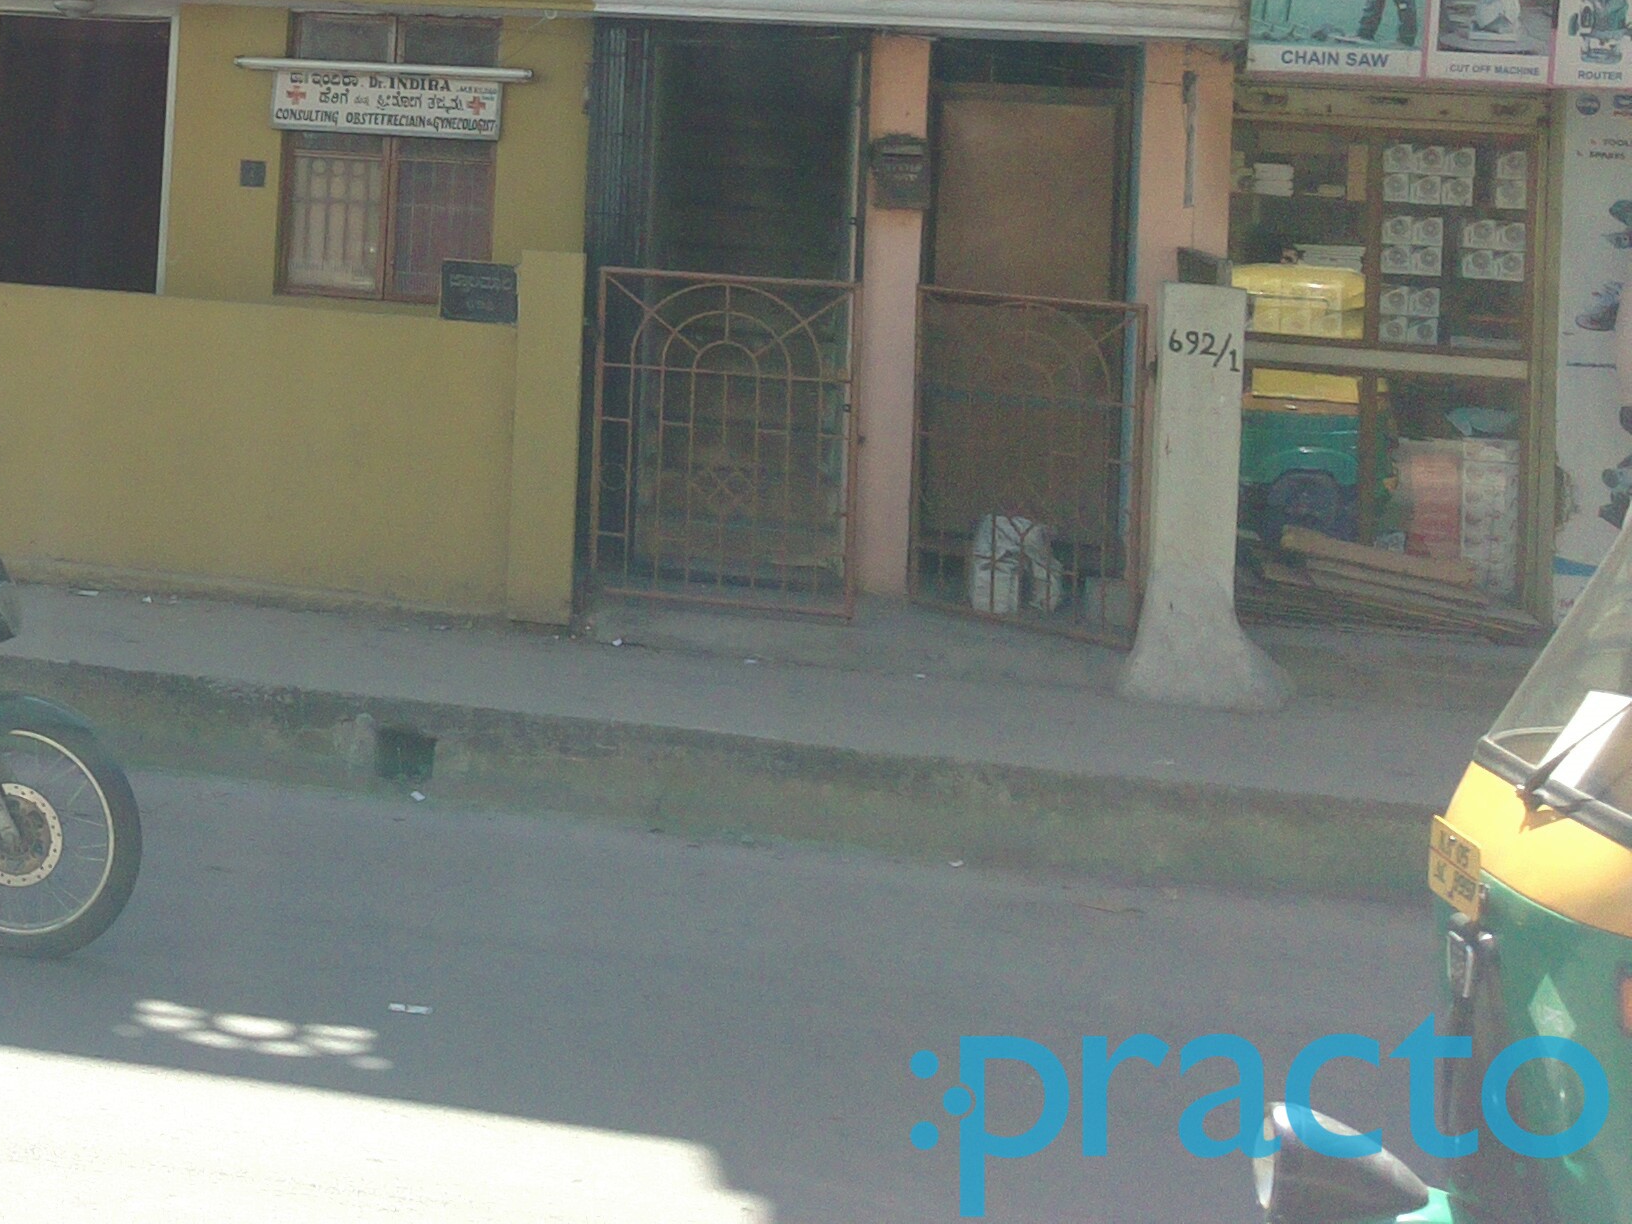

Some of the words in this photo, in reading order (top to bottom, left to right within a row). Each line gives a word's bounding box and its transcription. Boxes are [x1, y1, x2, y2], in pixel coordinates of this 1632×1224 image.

[1280, 50, 1339, 67] CHAIN
[1345, 52, 1389, 68] SAW
[1449, 64, 1469, 73] CUT
[1472, 65, 1492, 74] OFF
[1494, 66, 1540, 76] MACHINE
[1577, 70, 1623, 80] ROUTER
[369, 78, 387, 89] Dr.
[389, 78, 452, 93] INDIRA
[275, 107, 339, 124] CONSULTING
[1169, 329, 1240, 373] 692/1
